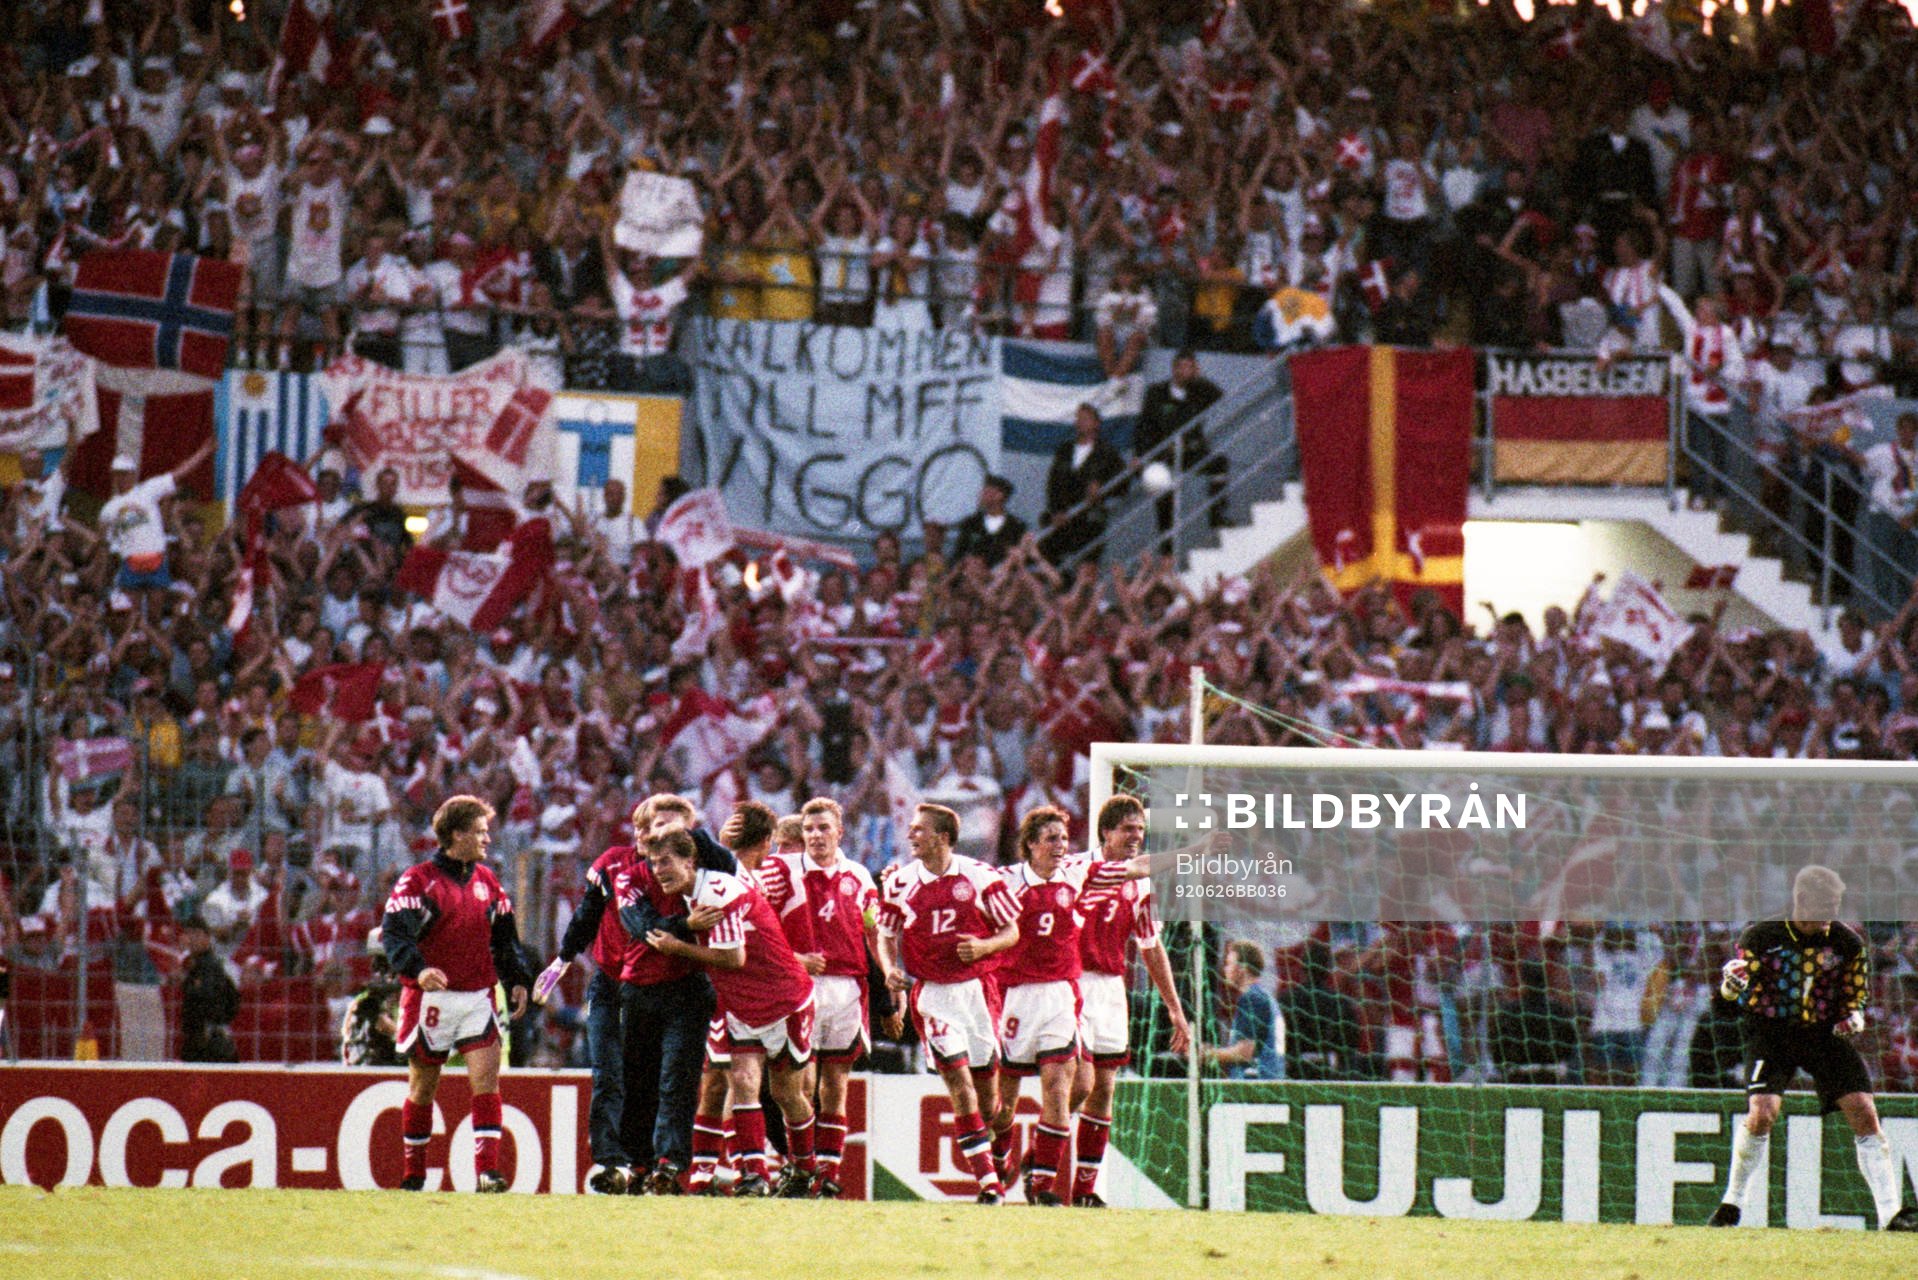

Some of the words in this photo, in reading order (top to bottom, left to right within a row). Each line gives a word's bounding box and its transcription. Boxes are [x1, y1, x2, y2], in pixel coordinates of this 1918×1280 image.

[864, 375, 993, 440] MFF
[695, 424, 988, 531] VIGGO
[818, 899, 835, 922] 4
[931, 908, 957, 936] 12
[1103, 899, 1119, 923] 3
[1037, 912, 1055, 936] 9
[425, 1006, 439, 1028] 8
[1004, 1016, 1020, 1040] 9
[1751, 1060, 1765, 1082] 1
[0, 1081, 606, 1194] oca-Col
